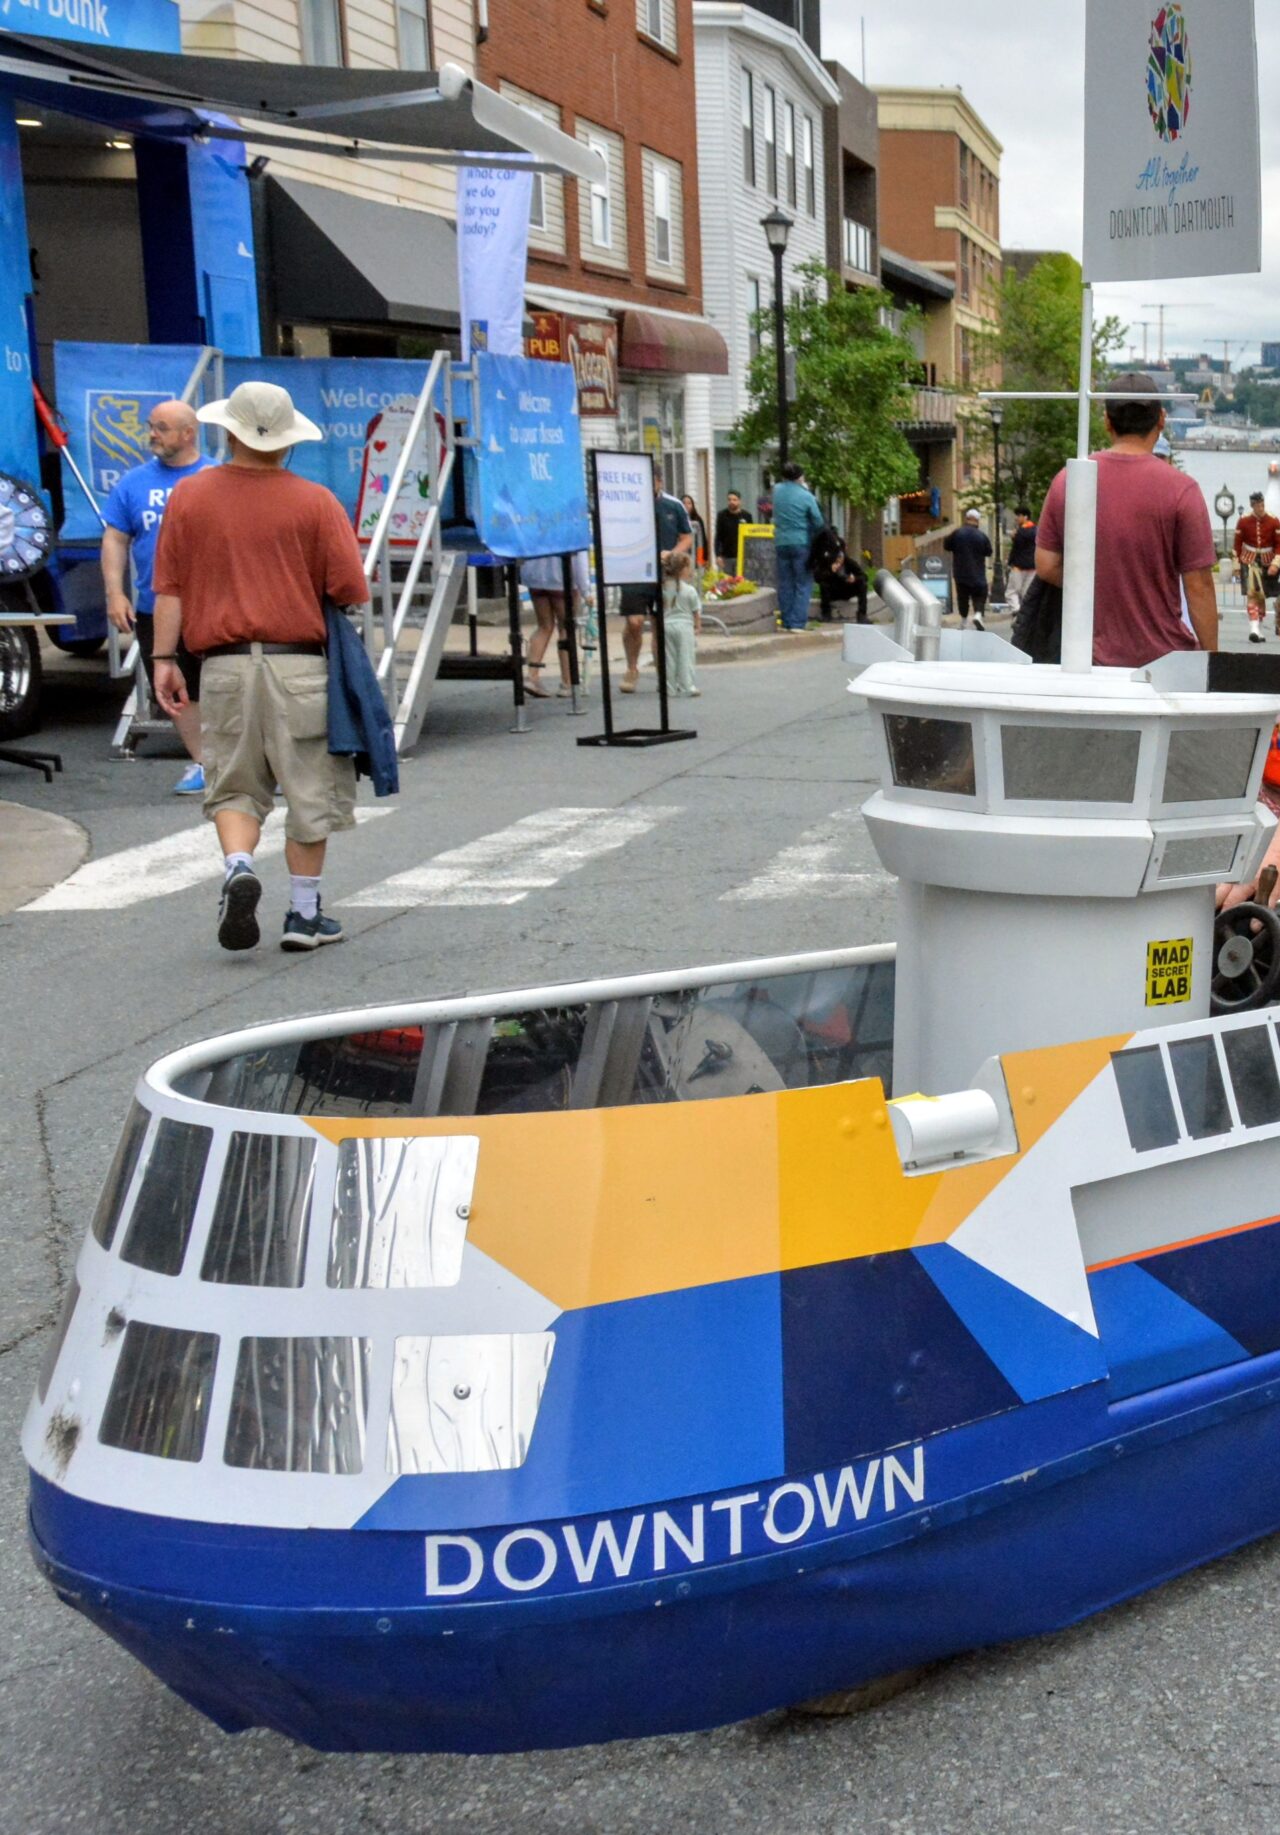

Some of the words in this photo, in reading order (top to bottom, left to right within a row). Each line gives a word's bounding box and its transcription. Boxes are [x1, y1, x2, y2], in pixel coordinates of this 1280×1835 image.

[480, 185, 496, 198] do
[1110, 205, 1168, 239] DOWNTOWN
[1174, 196, 1234, 233] DARTMOUTH
[530, 338, 560, 356] PUB
[598, 471, 620, 484] FREE
[621, 472, 644, 485] FACE
[599, 489, 641, 503] PAINTING
[1152, 945, 1190, 965] MAD
[1151, 964, 1189, 978] SECRET
[1151, 976, 1188, 999] LAB
[425, 1445, 925, 1597] DOWNTOWN
